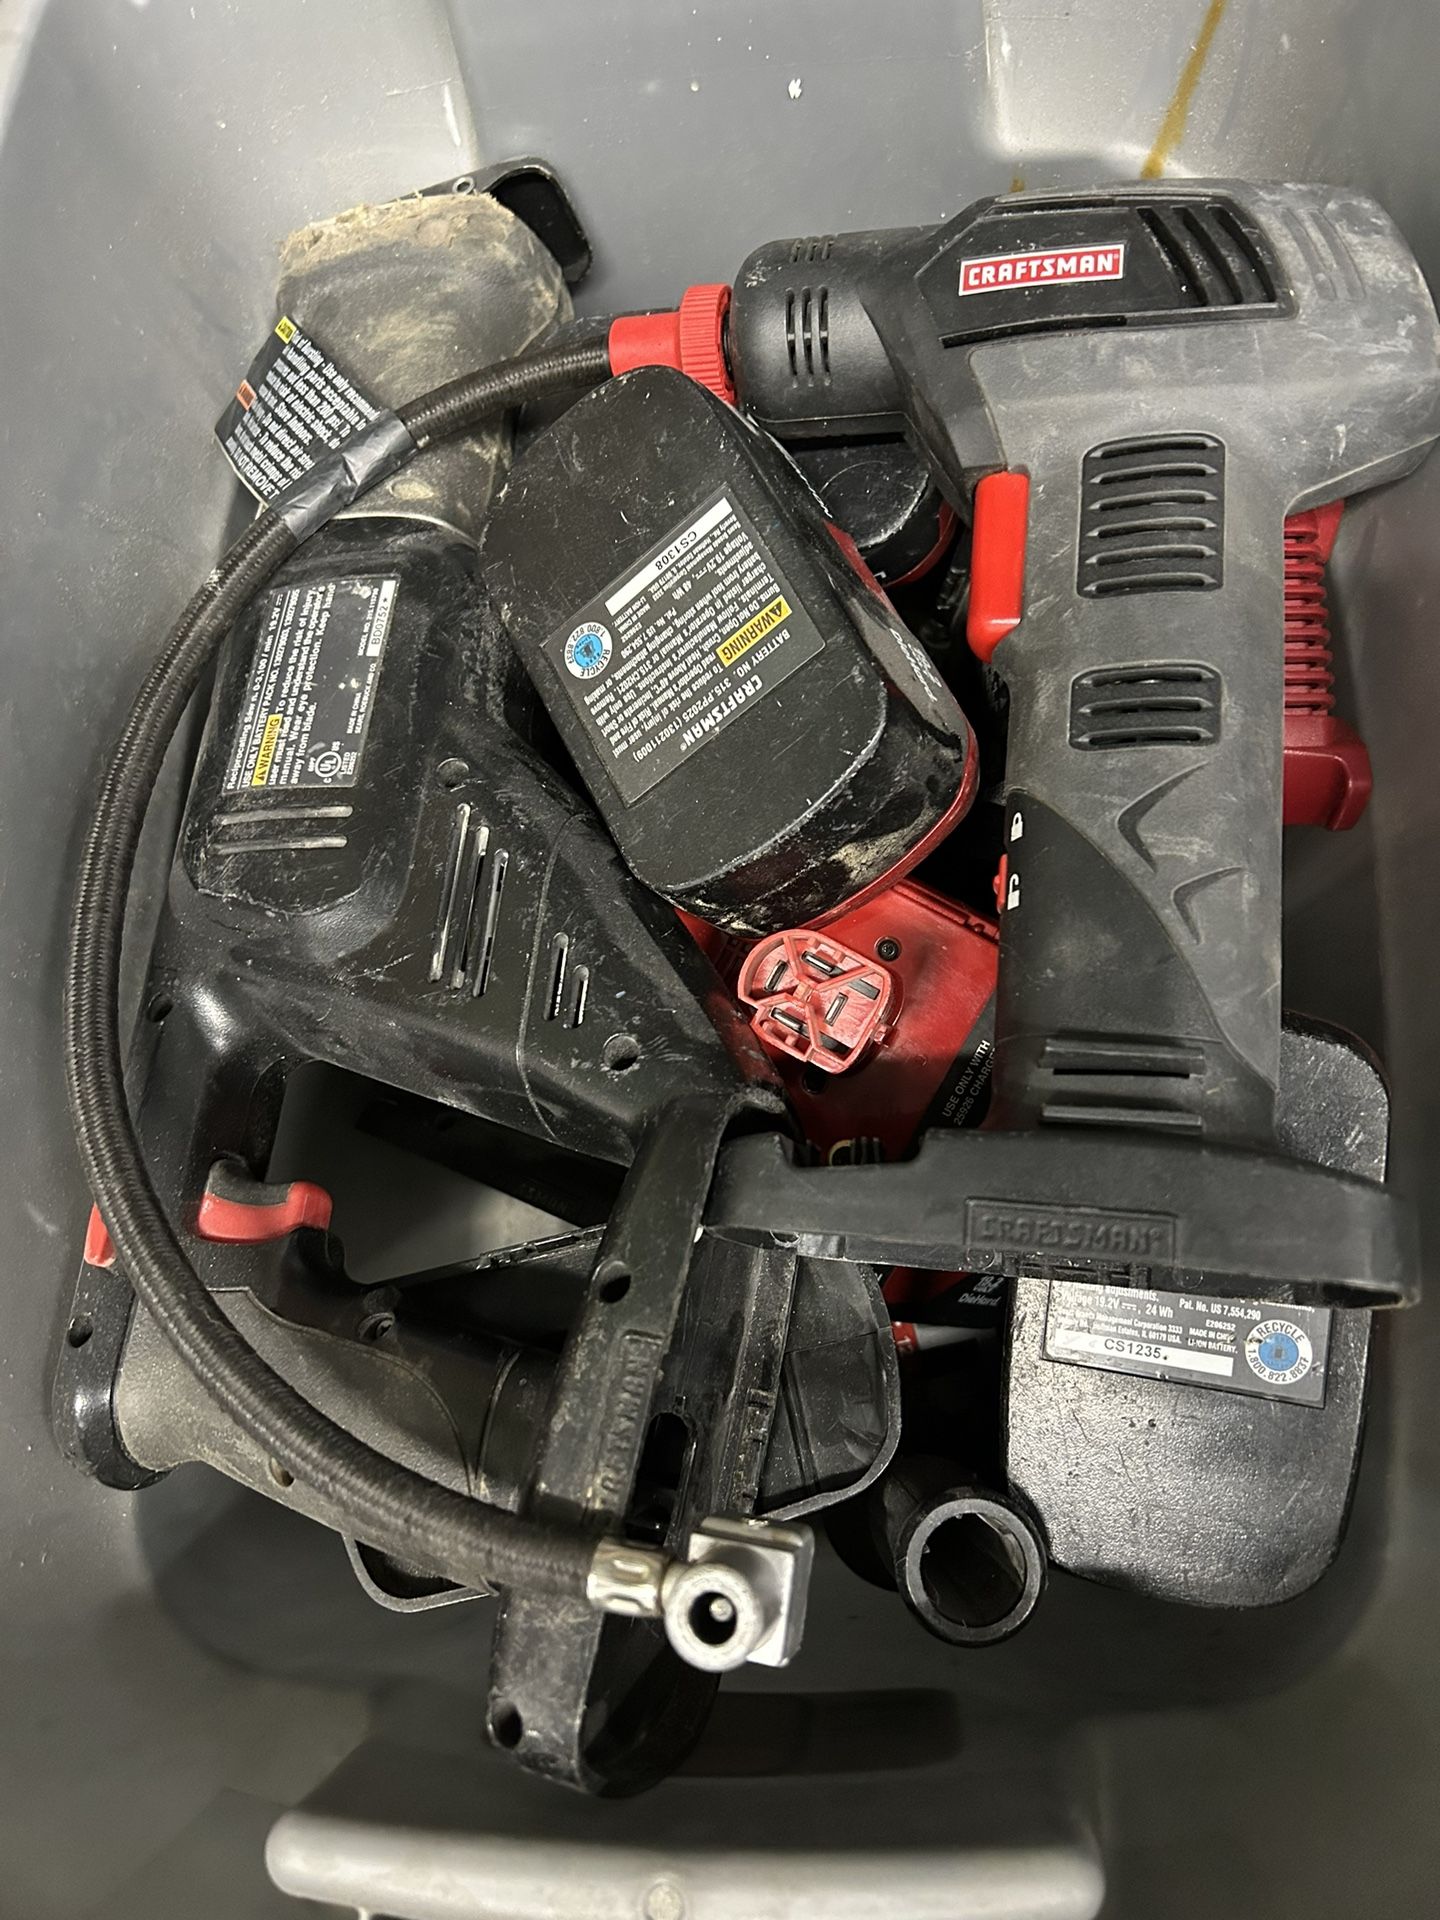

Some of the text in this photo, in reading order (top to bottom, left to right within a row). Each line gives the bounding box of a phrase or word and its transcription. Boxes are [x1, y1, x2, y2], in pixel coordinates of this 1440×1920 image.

[968, 253, 1115, 287] CRAFTSMAN
[331, 374, 349, 392] only
[293, 377, 309, 395] less
[304, 388, 321, 407] than
[315, 400, 334, 418] 200
[303, 366, 359, 428] parts acceptable
[273, 401, 292, 422] Store
[290, 399, 315, 424] electric
[309, 418, 332, 443] shock,
[274, 428, 303, 458] direct air
[263, 439, 294, 472] reduce the
[243, 458, 275, 495] REMOVE
[259, 458, 282, 485] crimps
[654, 530, 697, 570] CS1308
[722, 531, 748, 555] Voltage
[714, 541, 753, 576] adjustments.
[737, 551, 761, 574] battery
[722, 569, 740, 586] from
[741, 561, 766, 586] charger
[671, 586, 685, 600] Wh
[681, 580, 692, 592] 48
[710, 581, 725, 598] tool
[722, 583, 742, 604] listed
[757, 582, 780, 602] Burns.
[694, 592, 712, 610] when
[713, 598, 724, 609] in
[747, 599, 760, 612] Do
[267, 606, 280, 631] 19.2V
[671, 606, 696, 628] storing,
[682, 606, 715, 636] Operator's
[718, 617, 739, 635] Open,
[736, 607, 751, 623] Not
[302, 629, 314, 645] the
[645, 624, 656, 637] US
[645, 625, 673, 651] changing
[698, 632, 721, 652] Crush,
[721, 611, 774, 660] WARNING
[263, 634, 273, 652] min
[595, 572, 774, 726] Terminals. Follow Manufacturer's Instructions. Use only with
[659, 633, 684, 658] Manual
[274, 617, 307, 713] To reduce the risk of
[579, 647, 610, 676] RECYCLE
[610, 647, 648, 680] attachments,
[651, 652, 659, 664] or
[684, 648, 702, 667] Heat
[711, 662, 723, 674] To
[291, 645, 309, 696] understand
[667, 660, 687, 680] Above
[691, 669, 713, 691] reduce
[261, 682, 276, 706] PACK
[583, 683, 606, 705] making
[604, 677, 613, 688] or
[680, 687, 693, 700] the
[278, 610, 330, 784] manual. Wear eye protection. Keep
[285, 697, 297, 715] and
[590, 691, 615, 715] Remove
[608, 651, 716, 746] read Operator's Manual. Risk of Fire and
[622, 689, 653, 717] Incinerate
[632, 628, 790, 762] BATTERY NO. 315.PP2025 (130211009)
[667, 696, 681, 711] risk
[243, 702, 255, 723] Saw
[616, 712, 624, 724] or
[660, 706, 669, 719] of
[682, 675, 762, 745] CRAFTSMAN
[251, 707, 268, 745] BATTERY
[279, 715, 292, 737] read
[600, 718, 619, 737] Short
[627, 728, 642, 745] user
[258, 718, 279, 769] WARNING
[274, 738, 286, 762] must
[289, 702, 317, 784] away from blade.
[611, 740, 628, 758] must
[226, 723, 251, 789] Reciprocating
[245, 745, 259, 769] ONLY
[240, 769, 253, 788] USE
[267, 763, 279, 785] user
[942, 1038, 991, 1118] USE ONLY WITH
[1144, 1303, 1157, 1316] 24
[1158, 1304, 1173, 1318] Wh
[1178, 1297, 1194, 1310] Pat.
[1195, 1300, 1208, 1312] No.
[1210, 1302, 1222, 1314] US
[1223, 1304, 1261, 1320] 7,554,290
[1254, 1318, 1305, 1343] RECYCLE
